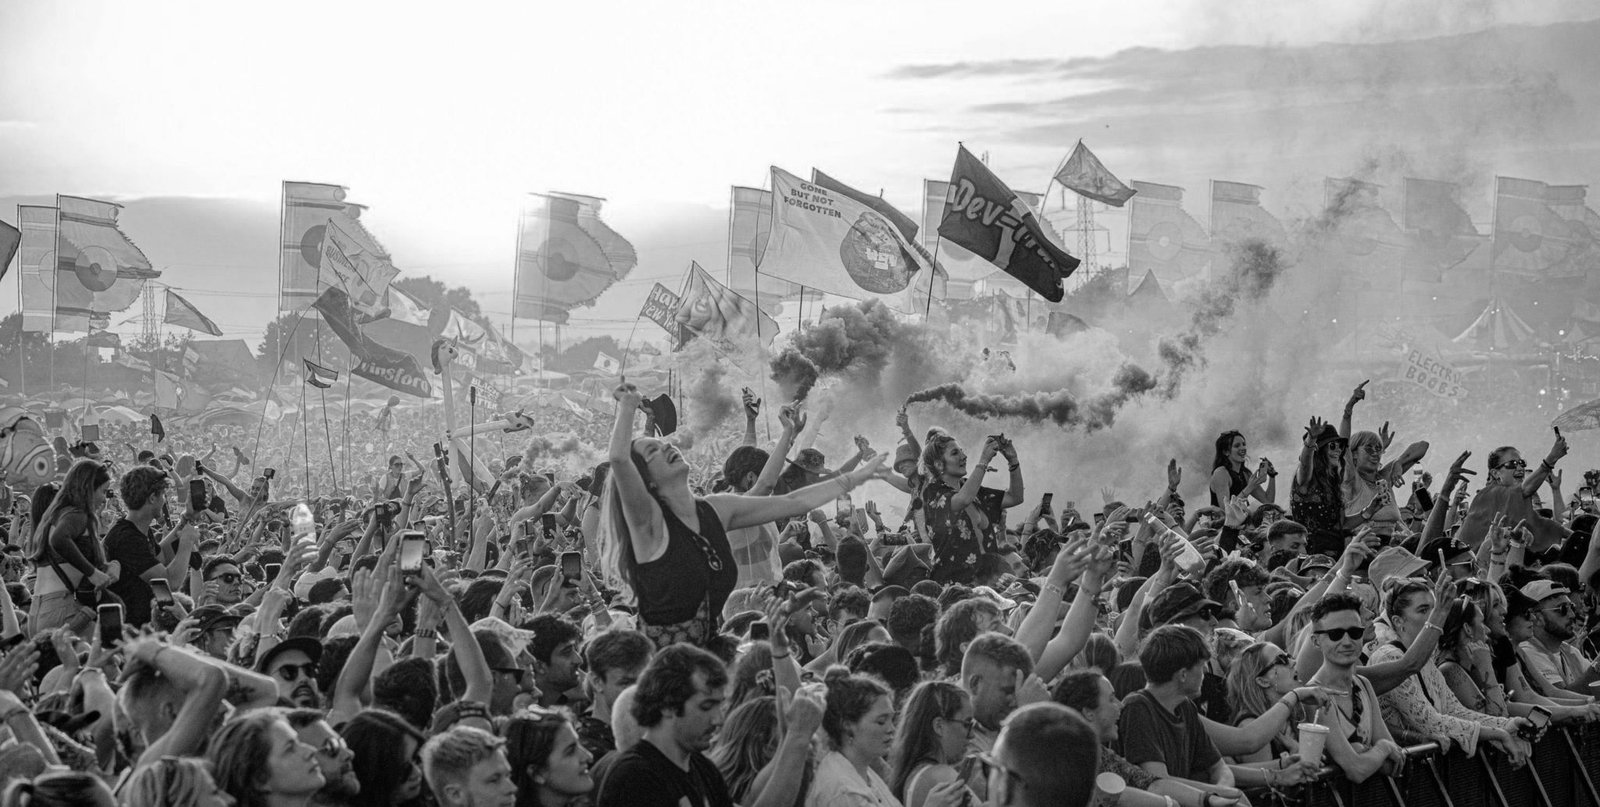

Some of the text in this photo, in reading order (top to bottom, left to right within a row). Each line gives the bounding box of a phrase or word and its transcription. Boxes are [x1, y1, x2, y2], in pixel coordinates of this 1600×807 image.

[791, 188, 834, 206] BUT NOT
[800, 183, 828, 196] GONE
[783, 195, 842, 219] FORGOTTEN
[650, 286, 680, 310] Hap
[1406, 365, 1459, 398] BOOBS
